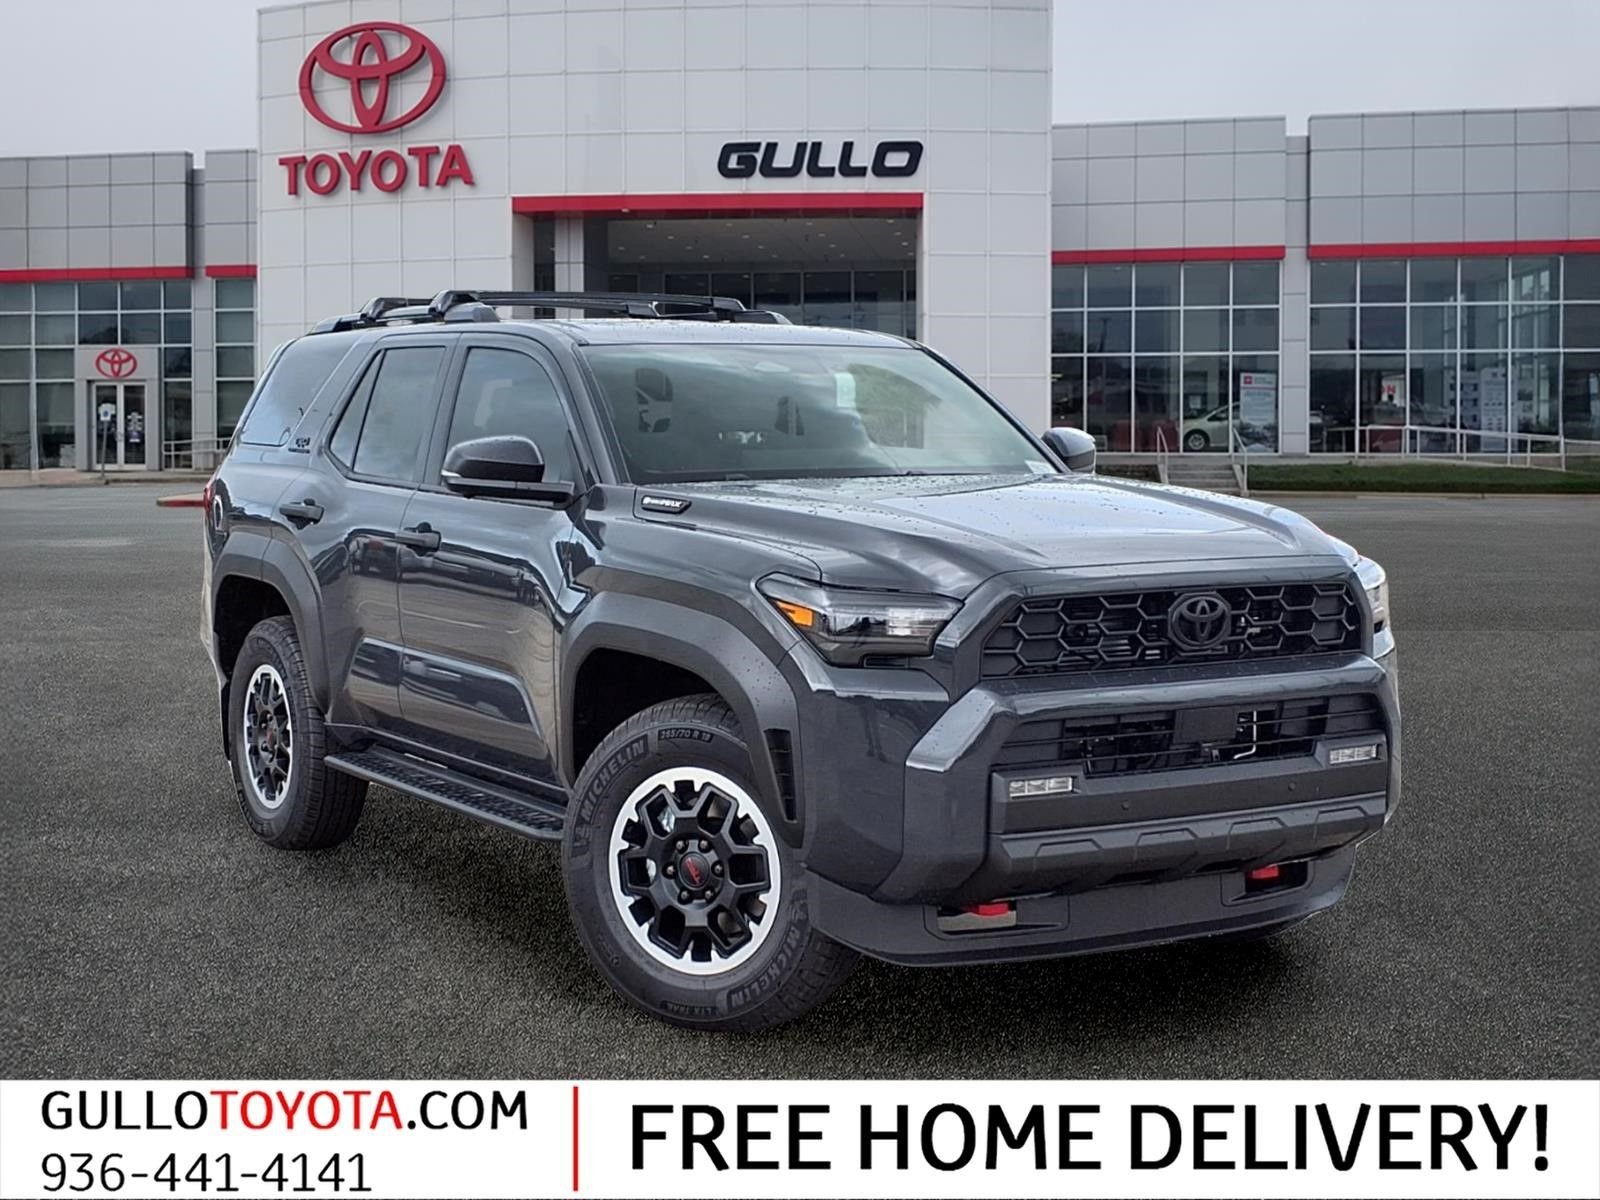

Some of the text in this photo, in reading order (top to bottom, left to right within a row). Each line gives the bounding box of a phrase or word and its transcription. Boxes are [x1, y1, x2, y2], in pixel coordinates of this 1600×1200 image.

[279, 144, 475, 195] TOYOTA
[718, 140, 924, 179] GULLO
[581, 739, 645, 821] MICHELIN
[731, 925, 800, 1009] MICHELIN
